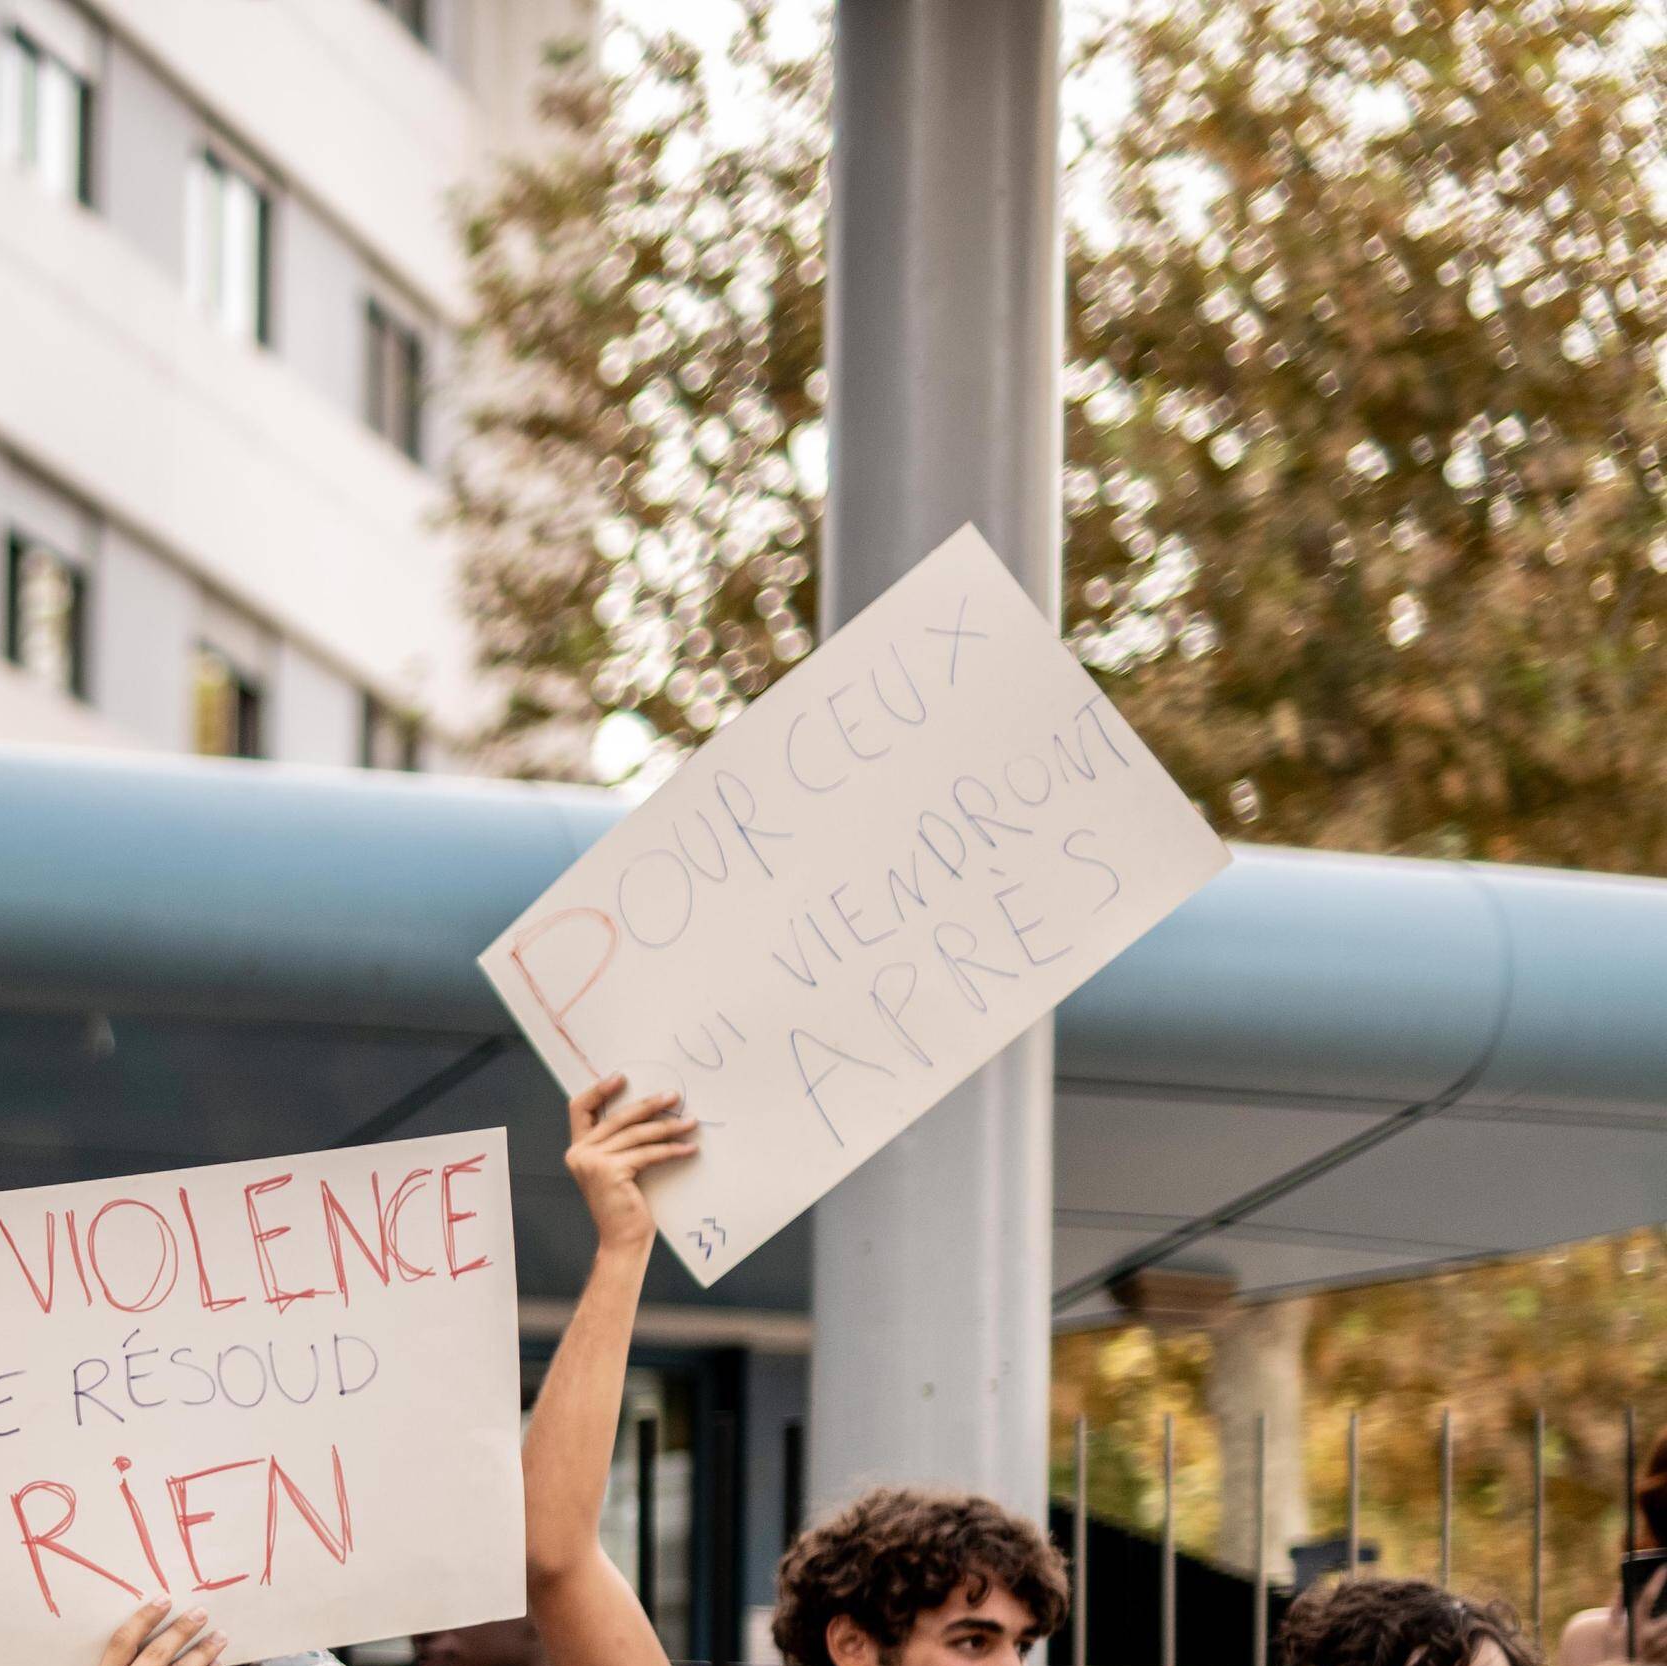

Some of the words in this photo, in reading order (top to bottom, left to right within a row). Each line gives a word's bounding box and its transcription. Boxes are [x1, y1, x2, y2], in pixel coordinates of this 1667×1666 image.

[510, 769, 793, 1081] POUR
[786, 595, 989, 793] CEUX
[771, 693, 1132, 988] VIENDRONT
[789, 828, 1121, 1148] APRÈS
[73, 1328, 381, 1427] RÉSOUD
